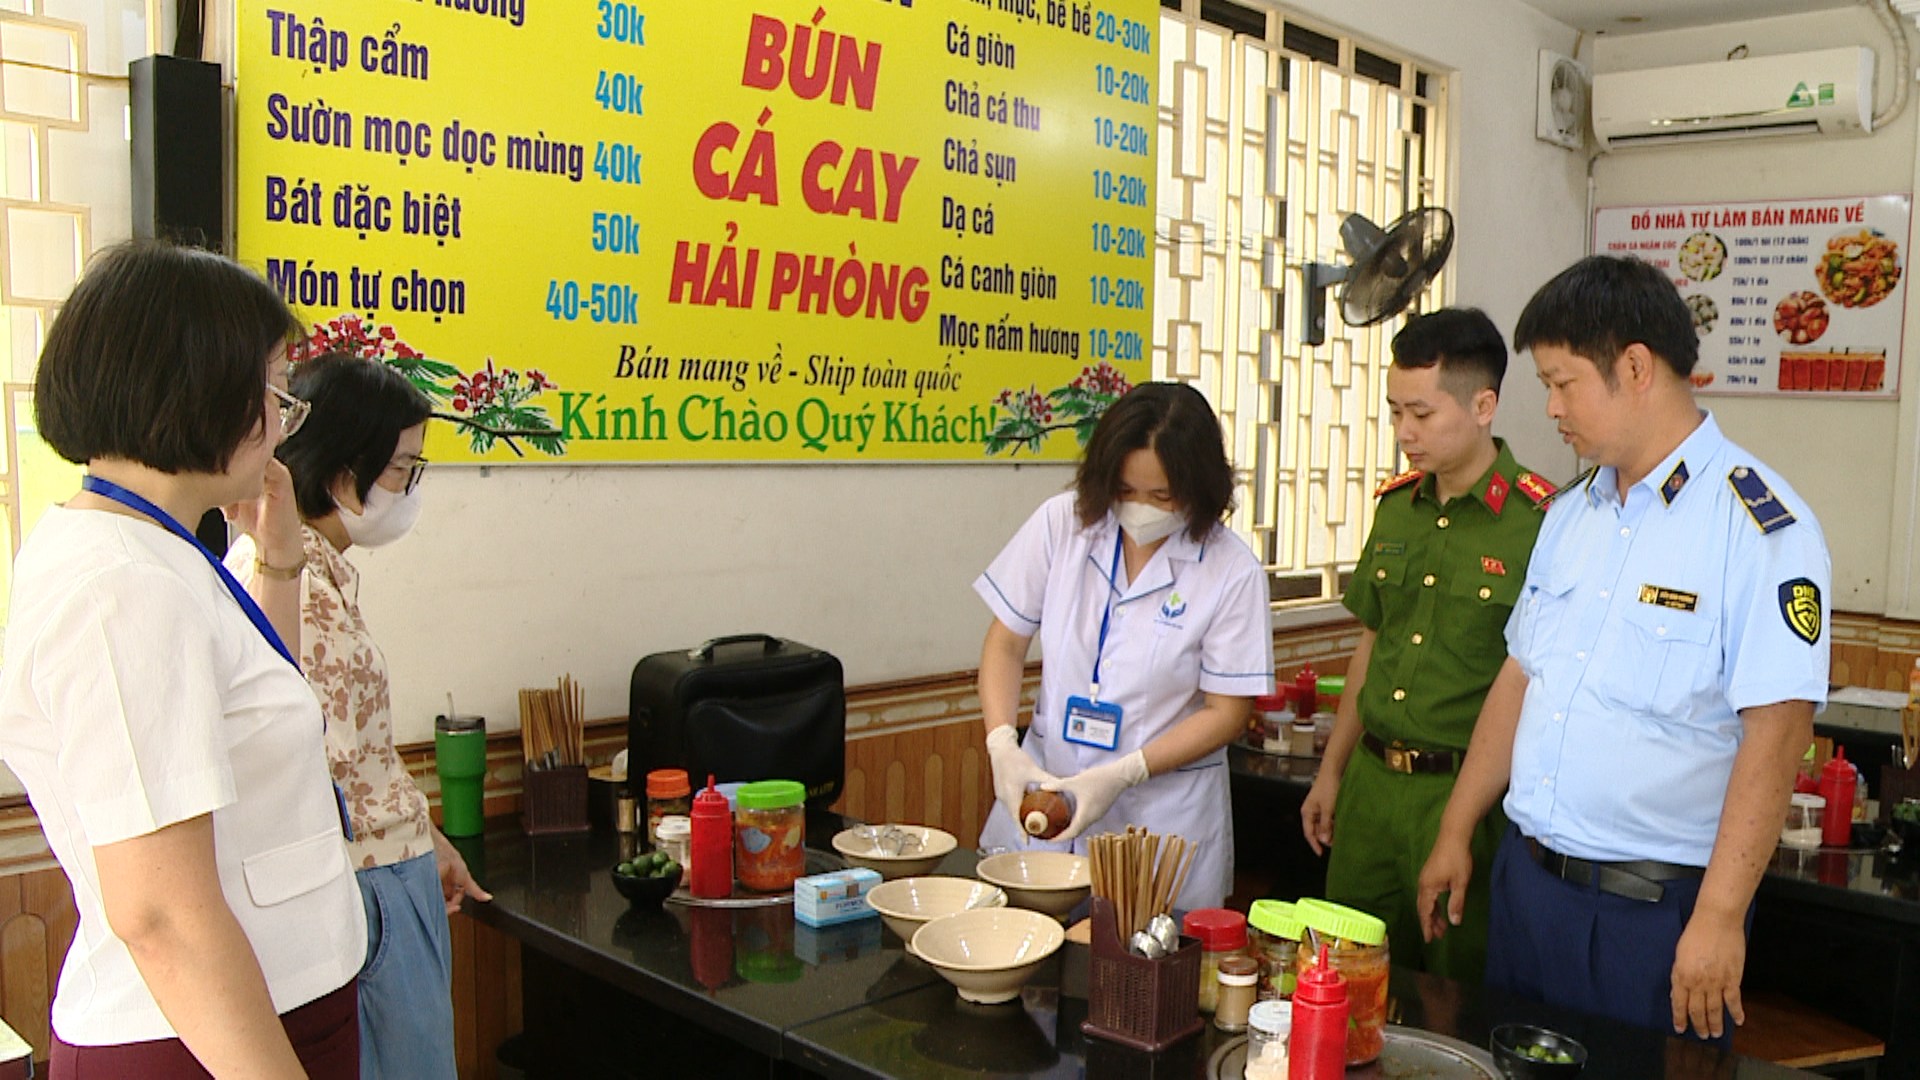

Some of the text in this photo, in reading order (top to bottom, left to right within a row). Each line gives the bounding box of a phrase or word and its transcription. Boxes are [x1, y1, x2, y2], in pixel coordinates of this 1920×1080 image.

[266, 9, 429, 80] Thập cẩm
[597, 1, 646, 46] 30k
[946, 21, 1015, 69] Cá giòn
[1095, 10, 1151, 55] 20-30k
[741, 6, 882, 111] BÚN
[595, 70, 644, 116] 40k
[945, 79, 1041, 131] Chả cá thu
[1095, 63, 1150, 105] 10-20k
[267, 93, 642, 185] Sườn mọc dọc mùng 40k
[1093, 116, 1149, 157] 10-20k
[692, 106, 920, 223] CÁ CAY
[943, 138, 1017, 188] Chả sụn
[1092, 169, 1147, 208] 10-20k
[266, 176, 640, 255] Bát đặc biệt 50k
[942, 196, 994, 238] Dạ cá
[1091, 222, 1146, 259] 10-20k
[1631, 200, 1865, 232] ĐỒ NHÀ TỰ LÀM BÁN MANG VỀ
[266, 258, 639, 325] Món tự chọn 40-50k
[668, 221, 931, 324] HẢI PHÒNG
[941, 255, 1145, 309] Cá canh giòn 10-20k
[939, 312, 1143, 361] Mọc nấm hương 10-20k
[614, 344, 670, 380] Bán
[678, 357, 750, 393] mang
[758, 343, 784, 384] về
[804, 354, 856, 396] Ship
[862, 358, 907, 389] toàn
[914, 354, 962, 399] quốc
[558, 391, 998, 453] Kính Chào Quý Khách!
